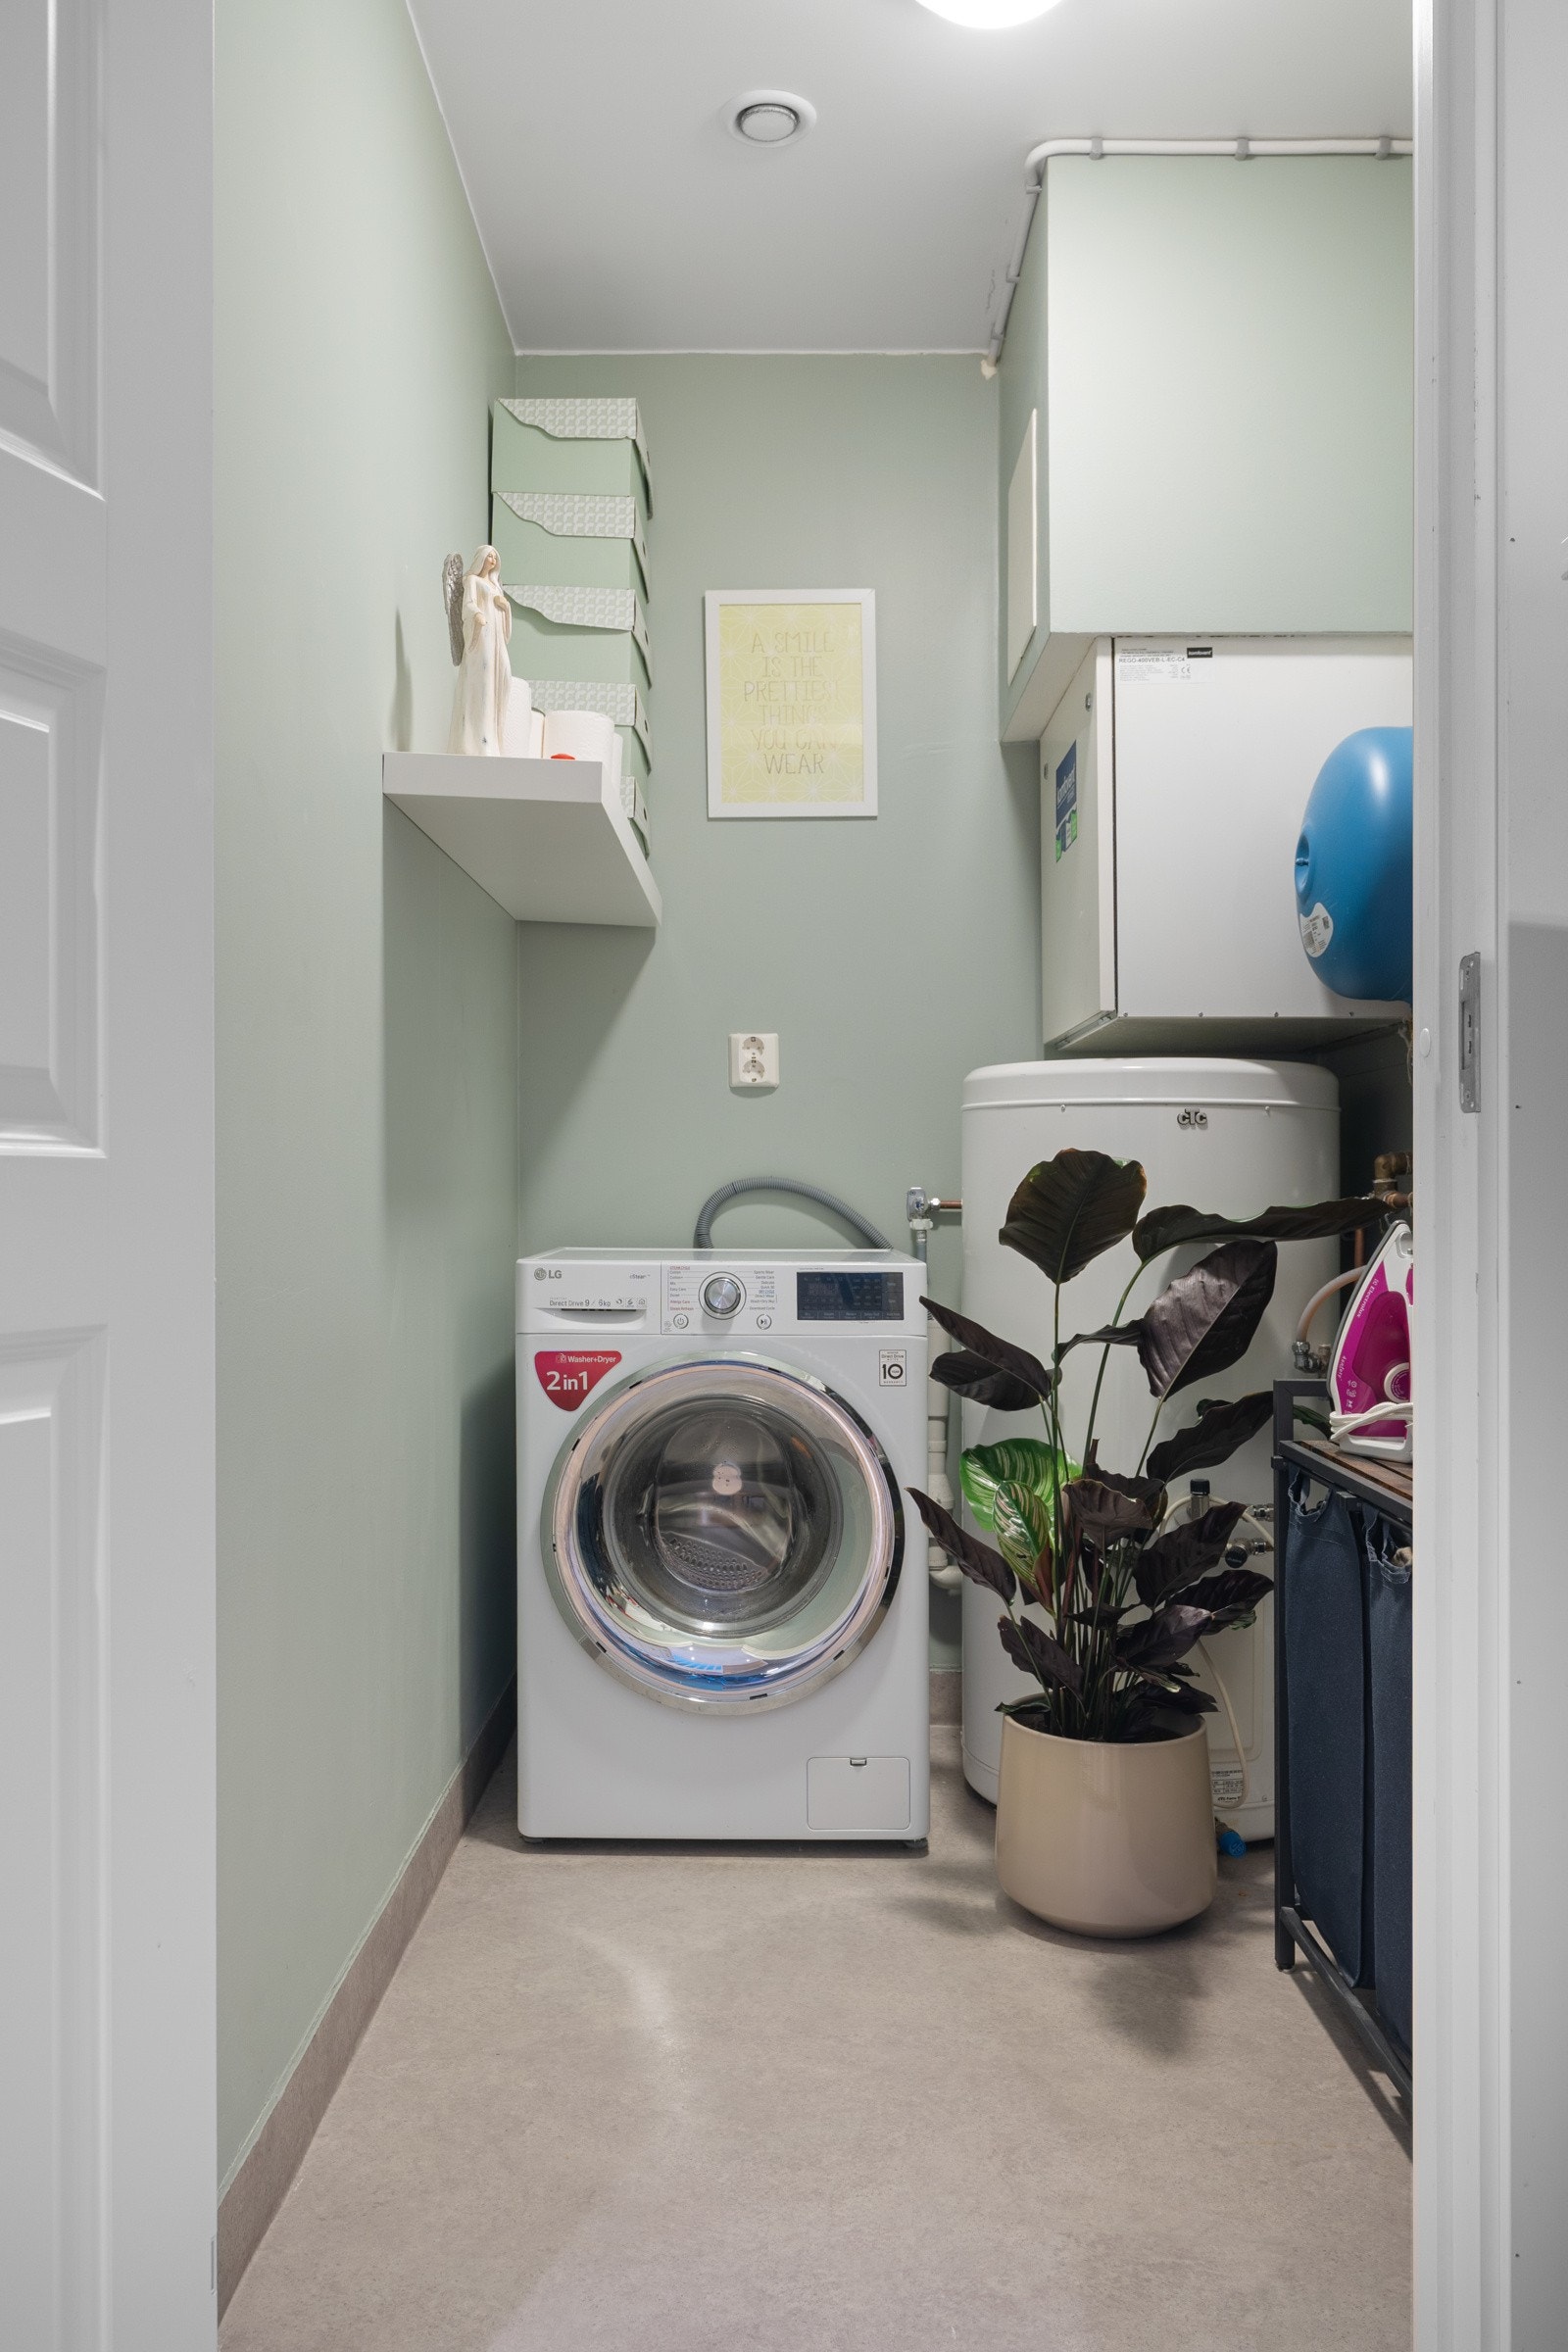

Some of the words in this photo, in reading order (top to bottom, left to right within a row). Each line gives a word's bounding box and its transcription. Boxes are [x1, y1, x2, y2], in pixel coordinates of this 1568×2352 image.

[751, 633, 765, 654] A
[774, 631, 835, 654] SMILE
[761, 656, 782, 677] IS
[790, 656, 823, 677] THE
[751, 728, 786, 751] YOU
[762, 753, 824, 774] WEAR
[548, 1270, 563, 1279] LG
[567, 1355, 616, 1364] Washer+Dryer
[546, 1371, 562, 1391] 2
[882, 1363, 904, 1379] 10
